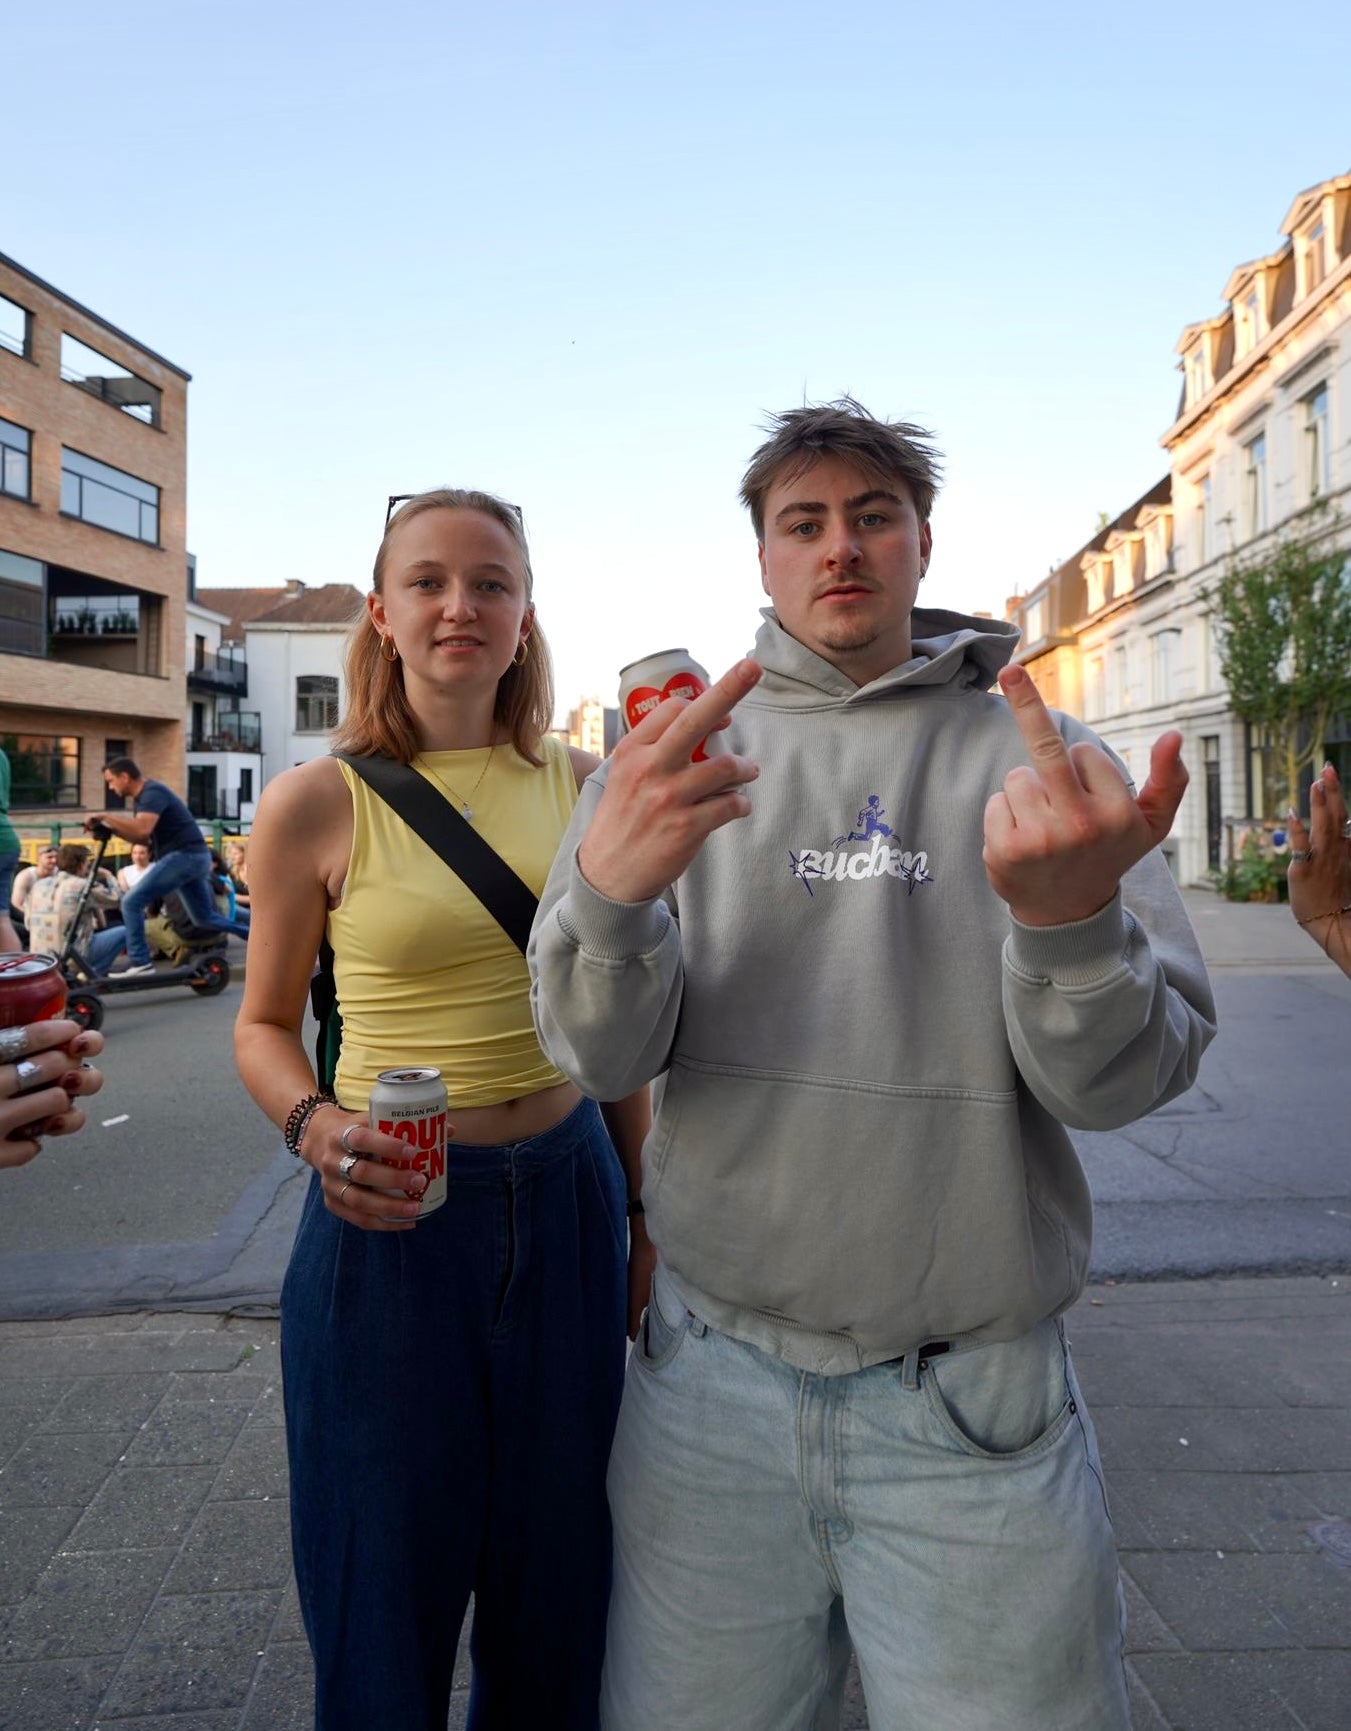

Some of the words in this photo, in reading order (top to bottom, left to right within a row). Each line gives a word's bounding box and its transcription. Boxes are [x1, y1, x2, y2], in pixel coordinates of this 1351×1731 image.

[635, 694, 661, 715] TOUT
[391, 1109, 425, 1117] BELGIAN
[379, 1112, 446, 1150] TOUT
